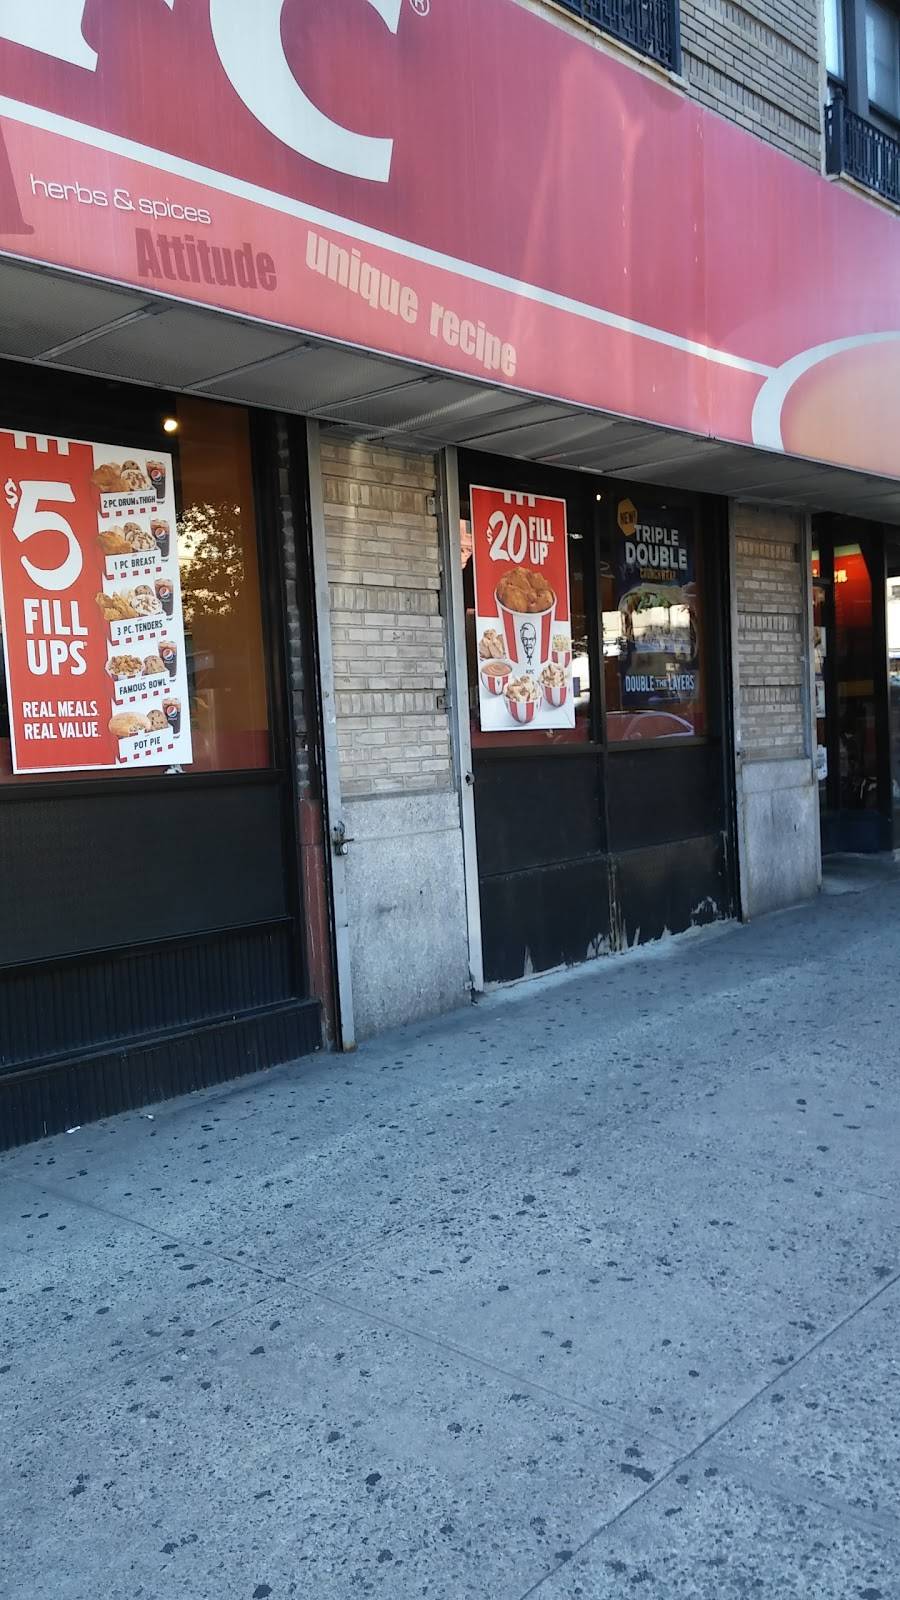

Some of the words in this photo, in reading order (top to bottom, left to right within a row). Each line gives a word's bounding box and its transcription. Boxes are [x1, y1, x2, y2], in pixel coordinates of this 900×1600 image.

[30, 173, 109, 207] herbs
[113, 188, 135, 210] &
[139, 197, 212, 225] spices
[135, 227, 278, 291] Attitude
[305, 230, 418, 324] unique
[429, 301, 517, 377] recipe
[103, 500, 108, 509] 2
[109, 499, 117, 508] PC
[118, 497, 135, 507] DRUM
[139, 495, 156, 505] THIGH
[486, 510, 528, 564] $20
[528, 516, 555, 542] FILL
[634, 524, 680, 546] TRIPLE
[114, 561, 118, 571] 1
[120, 560, 128, 569] PC
[131, 556, 156, 567] BREAST
[529, 541, 549, 565] UP
[625, 541, 688, 569] DOUBLE
[23, 598, 89, 636] FILL
[117, 627, 121, 636] 3
[134, 620, 163, 633] TENDERS
[26, 639, 87, 675] UPS
[119, 681, 147, 696] FAMOUS
[148, 678, 167, 690] BOWL
[625, 675, 655, 692] DOUBLE
[667, 673, 695, 691] LAYERS
[22, 701, 56, 718] REAL
[24, 722, 58, 740] REAL
[134, 739, 148, 750] POT
[150, 736, 161, 746] PIE
